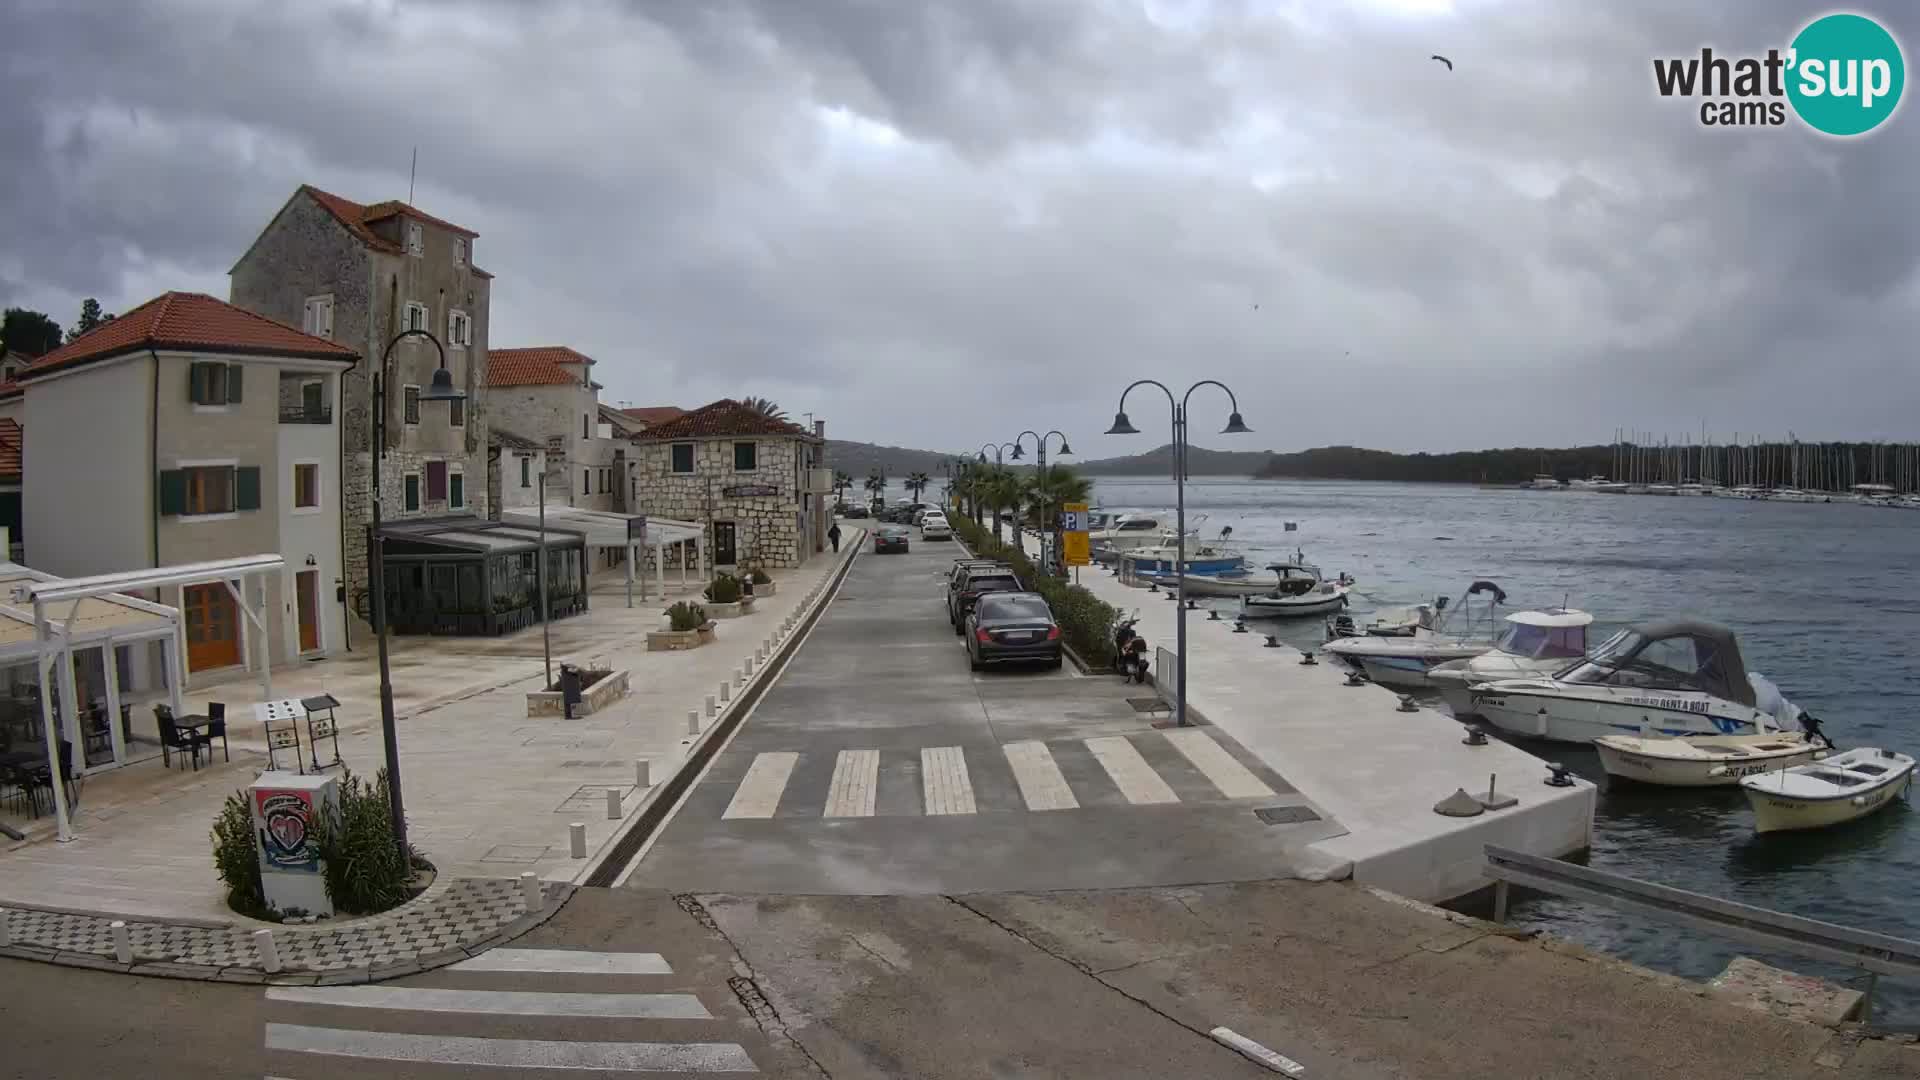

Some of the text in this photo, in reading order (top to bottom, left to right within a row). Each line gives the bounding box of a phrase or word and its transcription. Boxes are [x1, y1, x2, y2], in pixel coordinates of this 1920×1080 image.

[1065, 513, 1076, 529] P
[1660, 698, 1681, 709] RENT
[1682, 700, 1689, 711] A
[1690, 701, 1711, 713] BOAT
